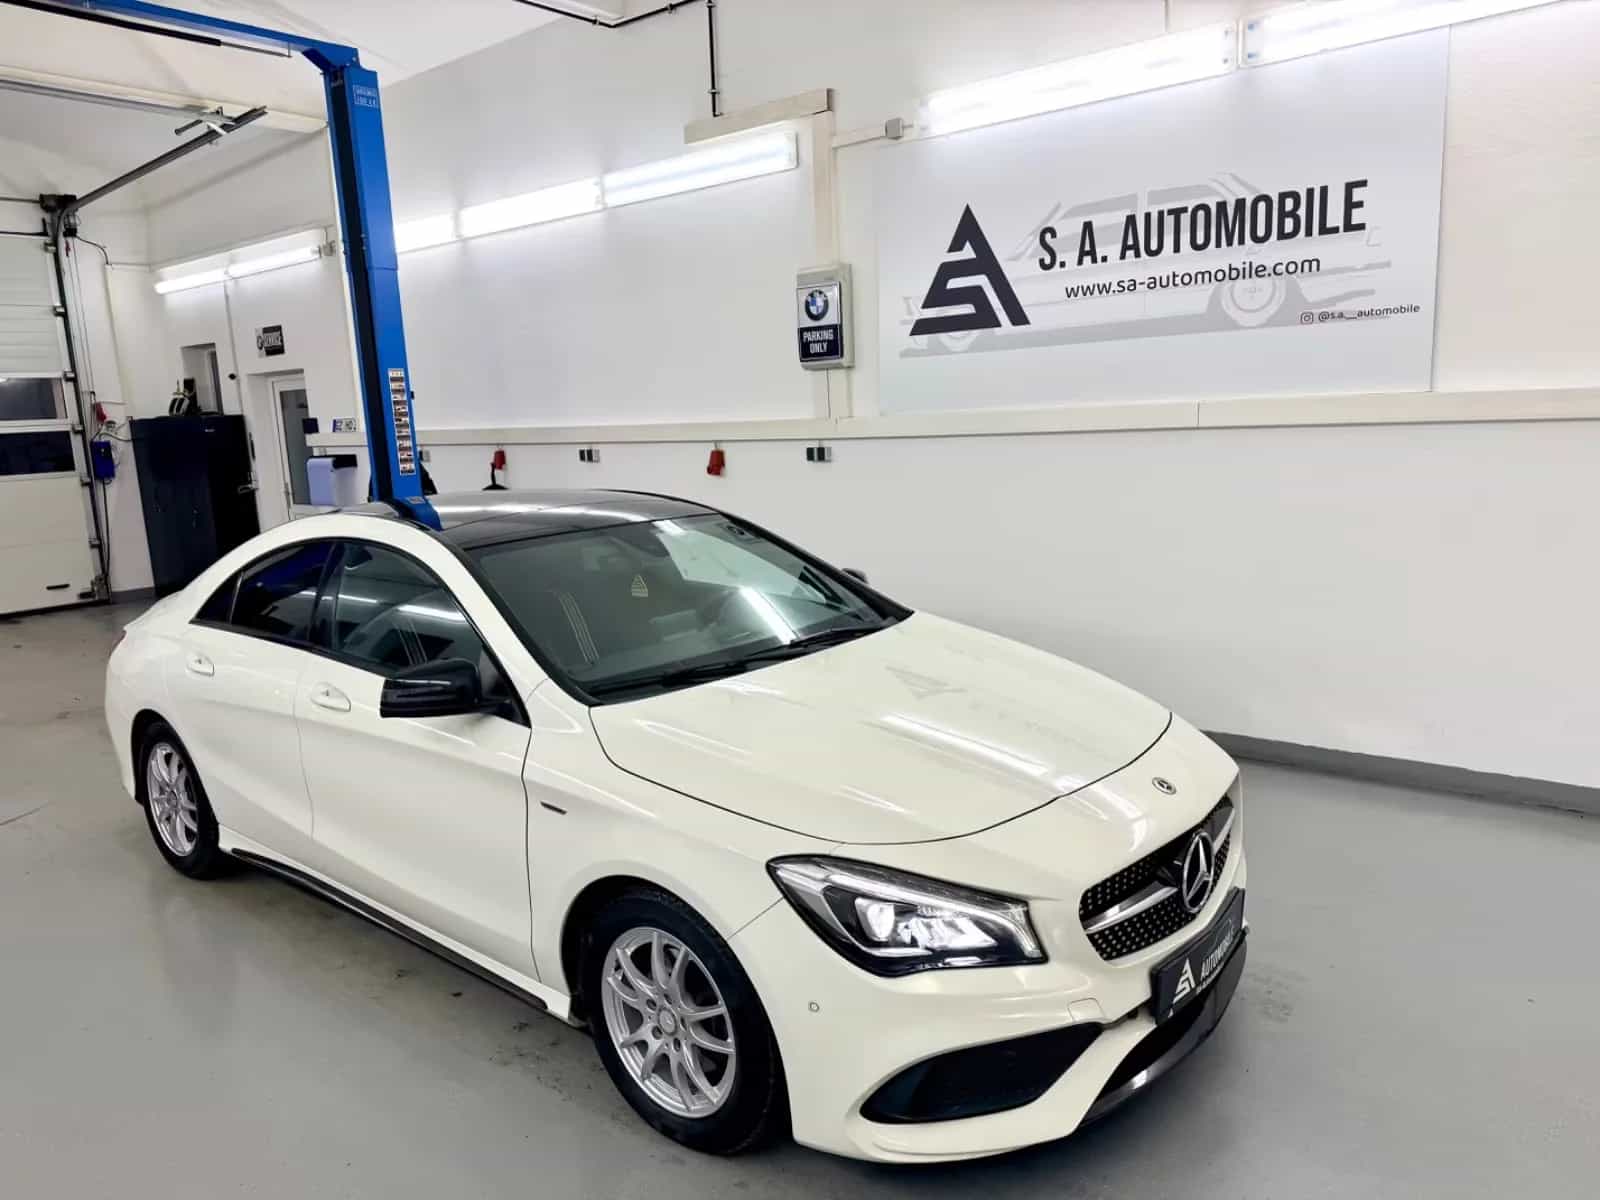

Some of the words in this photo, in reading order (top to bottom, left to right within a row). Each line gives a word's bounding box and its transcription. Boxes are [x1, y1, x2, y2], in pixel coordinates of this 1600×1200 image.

[1038, 225, 1066, 271] S.
[1076, 220, 1109, 266] A.
[1119, 179, 1368, 261] AUTOMOBILE
[1065, 257, 1321, 299] www.sa-automobile.com
[802, 329, 834, 343] PARKING
[809, 342, 828, 354] ONLY
